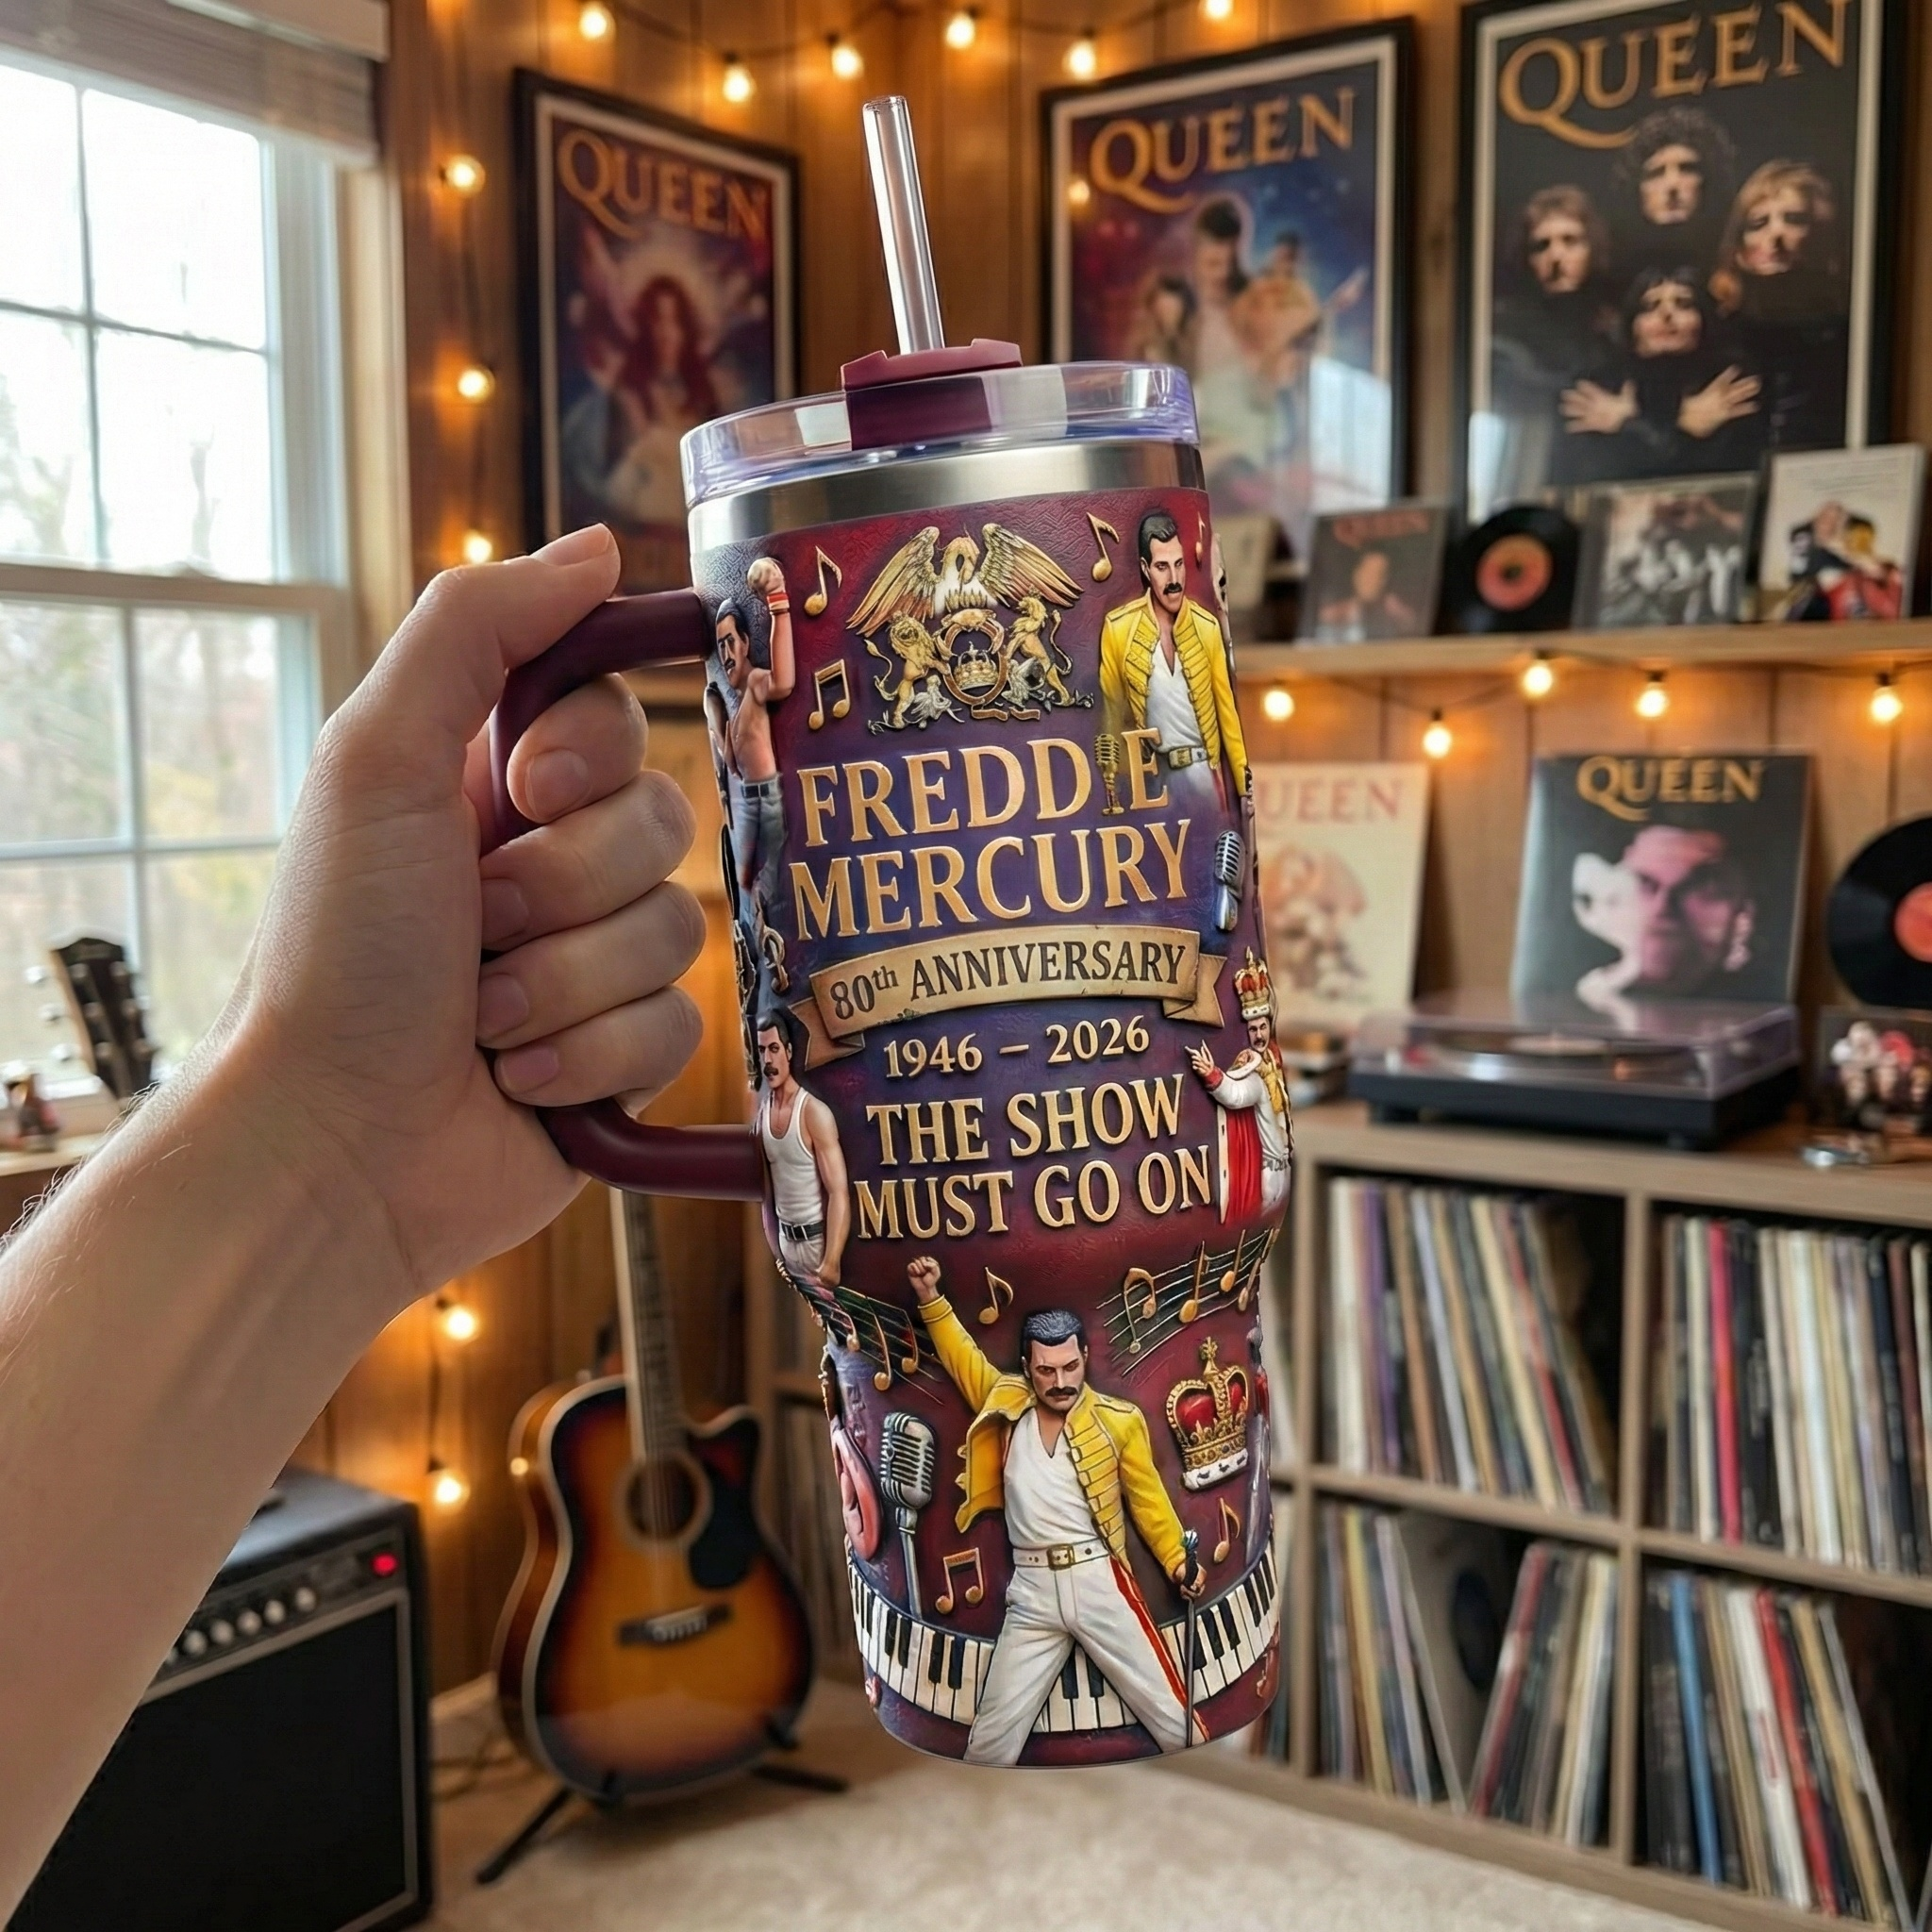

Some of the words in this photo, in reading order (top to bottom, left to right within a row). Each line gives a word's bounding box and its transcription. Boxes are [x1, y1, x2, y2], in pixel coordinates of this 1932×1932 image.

[1498, 0, 1849, 149] QUEEN
[557, 130, 768, 240] QUEEN
[1089, 87, 1357, 213] QUEEN
[796, 727, 1169, 847] FREDDE
[1251, 776, 1405, 824] UEEN
[1575, 753, 1764, 823] QUEEN
[789, 818, 1191, 941] MERCURY
[829, 965, 899, 1021] 80th
[909, 940, 1187, 1003] ANNIVERSARY
[883, 1032, 983, 1079] 1946
[1045, 1014, 1150, 1064] 2026
[866, 1096, 990, 1166] THE
[1006, 1073, 1185, 1158] SHOW
[853, 1169, 1014, 1240] MUST
[1034, 1158, 1121, 1227] GO
[1137, 1144, 1212, 1215] ON
